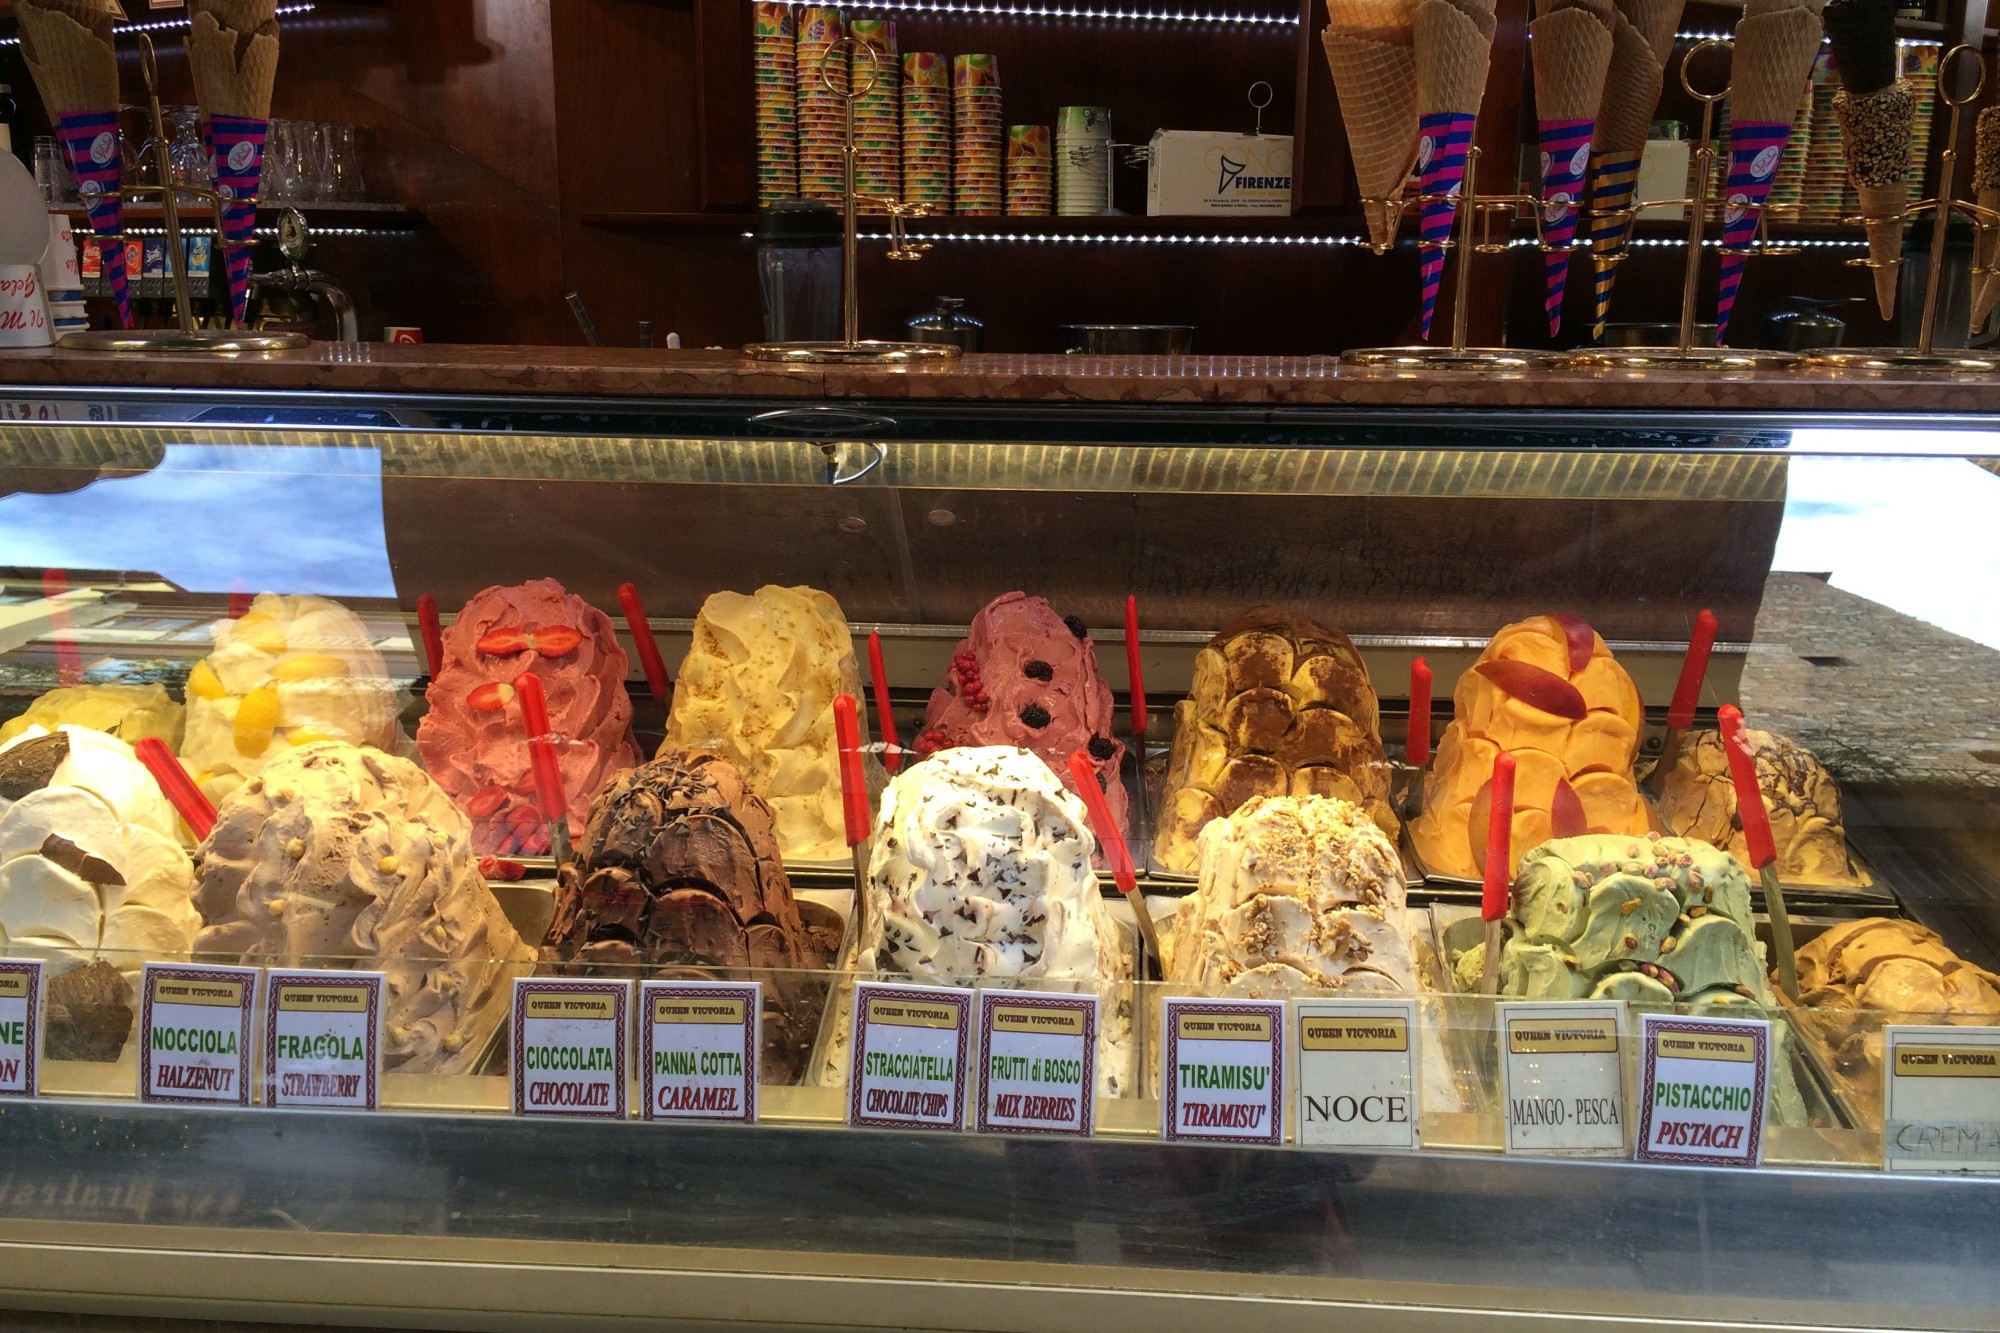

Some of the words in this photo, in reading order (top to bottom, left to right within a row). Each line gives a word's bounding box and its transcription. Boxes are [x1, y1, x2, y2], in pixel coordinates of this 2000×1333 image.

[1236, 176, 1290, 189] FIRENZE
[0, 272, 35, 298] Gela
[0, 310, 26, 330] M
[159, 986, 188, 997] QUEEN
[191, 988, 234, 999] VICTORIA
[284, 994, 313, 1003] QUEEN
[316, 994, 359, 1004] VICTORIA
[531, 1001, 561, 1010] QUEEN
[564, 1002, 607, 1010] VICTORIA
[659, 1006, 690, 1015] QUEEN
[692, 1006, 736, 1016] VICTORIA
[874, 1006, 904, 1017] QUEEN
[906, 1008, 950, 1020] VICTORIA
[998, 1014, 1028, 1024] QUEEN
[1031, 1016, 1075, 1026] VICTORIA
[1183, 1021, 1214, 1031] QUEEN
[1217, 1022, 1262, 1032] VICTORIA
[152, 1026, 238, 1054] NOCCIOLA
[1307, 1028, 1343, 1039] QUEEN
[1345, 1028, 1398, 1039] VICTORIA
[1514, 1030, 1550, 1041] QUEEN
[1554, 1029, 1606, 1041] VICTORIA
[1662, 1039, 1696, 1050] QUEEN
[1698, 1041, 1745, 1052] VICTORIA
[277, 1035, 364, 1060] FRAGOLA
[526, 1046, 614, 1071] CIOCCOLATA
[655, 1052, 697, 1076] PANNA
[701, 1052, 742, 1076] COTTA
[866, 1052, 954, 1082] STRACCIATELLA
[991, 1055, 1029, 1082] FRUTTI
[1032, 1057, 1042, 1082] di
[1044, 1059, 1081, 1085] BOSCO
[156, 1064, 235, 1092] HALZENUT
[282, 1073, 362, 1098] STRAWBERRY
[1179, 1064, 1270, 1090] TIRAMISU'
[529, 1082, 610, 1107] CHOCOLATE
[658, 1086, 739, 1112] CARAMEL
[866, 1088, 922, 1116] CHOCOLATE
[920, 1094, 948, 1118] CHIPS
[1656, 1082, 1751, 1112] PISTACCHIO
[994, 1093, 1020, 1119] MIX
[1022, 1095, 1076, 1122] BERRIES
[1182, 1101, 1267, 1128] TIRAMISU'
[1303, 1095, 1408, 1123] NOCE
[1512, 1098, 1565, 1126] MANGO
[1576, 1098, 1619, 1125] PESCA
[1656, 1120, 1744, 1149] PISTACH
